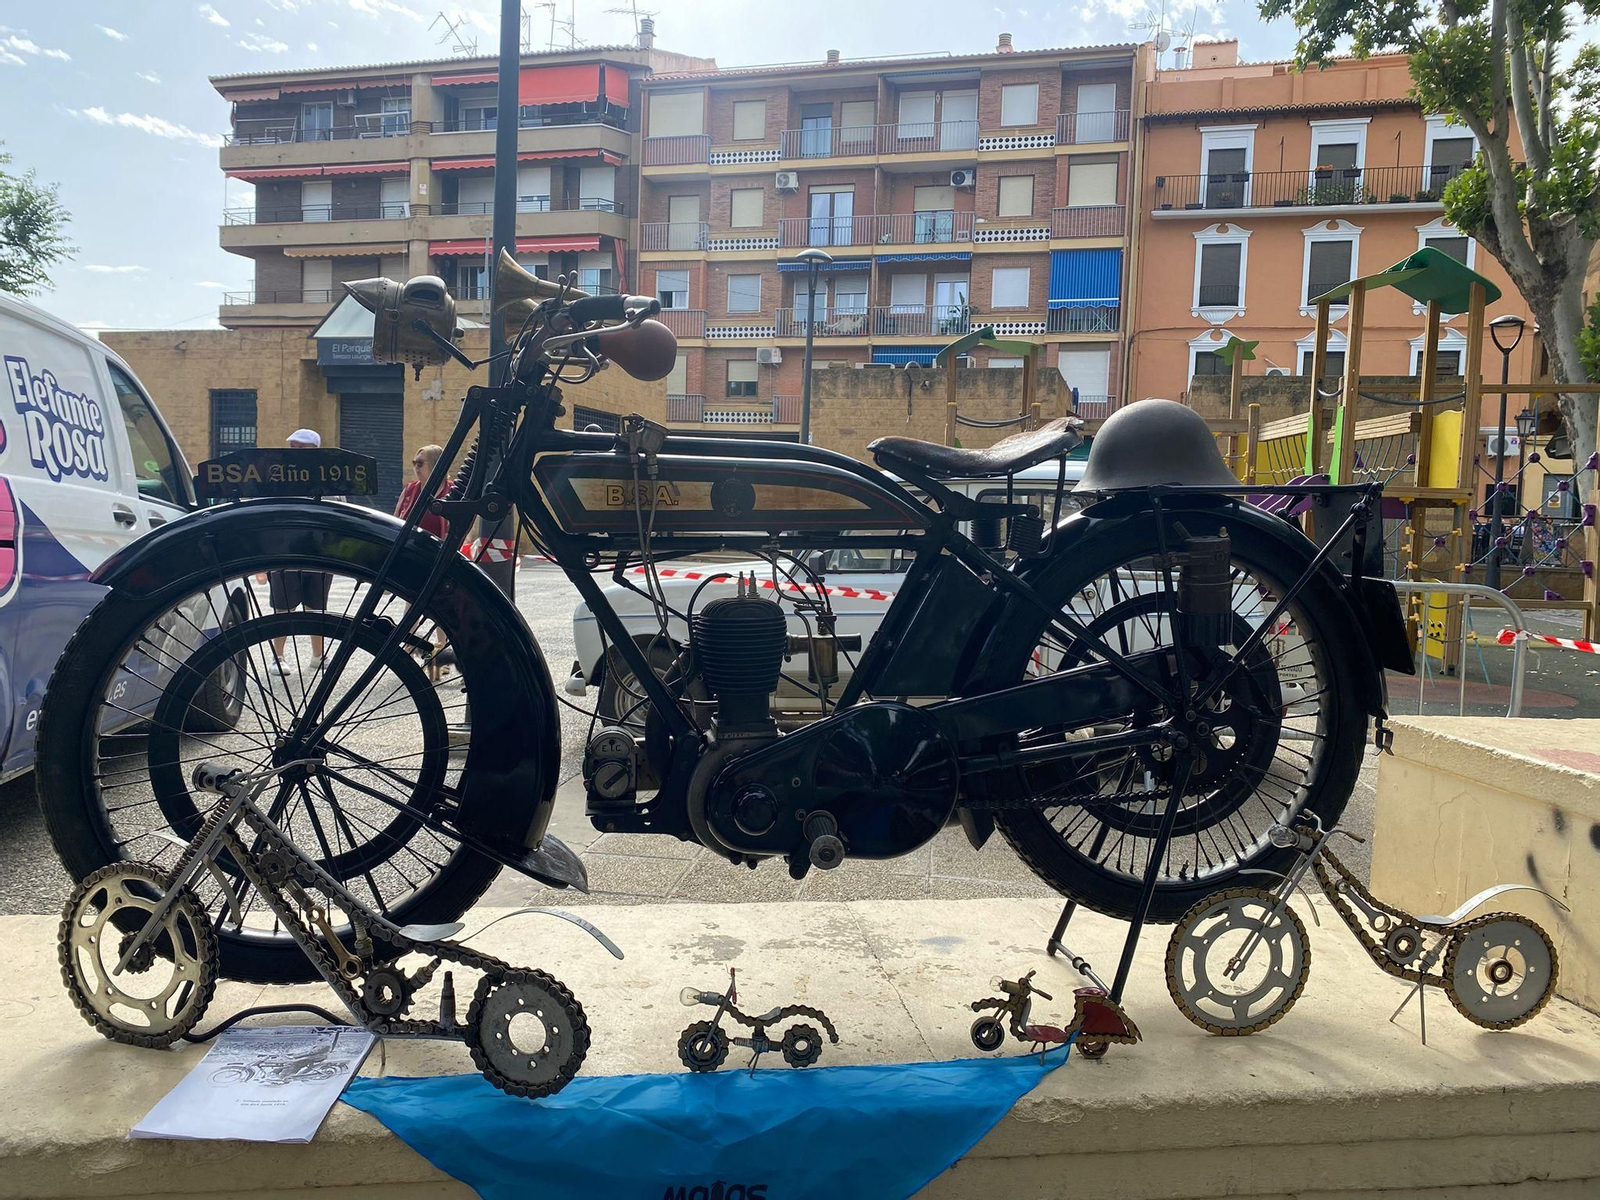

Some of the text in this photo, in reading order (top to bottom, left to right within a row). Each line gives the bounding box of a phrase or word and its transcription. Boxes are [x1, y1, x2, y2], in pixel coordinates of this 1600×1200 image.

[332, 344, 371, 355] El Parque
[5, 358, 103, 434] Elefante
[25, 410, 107, 478] Rosa
[207, 464, 367, 483] BSA Año 1918
